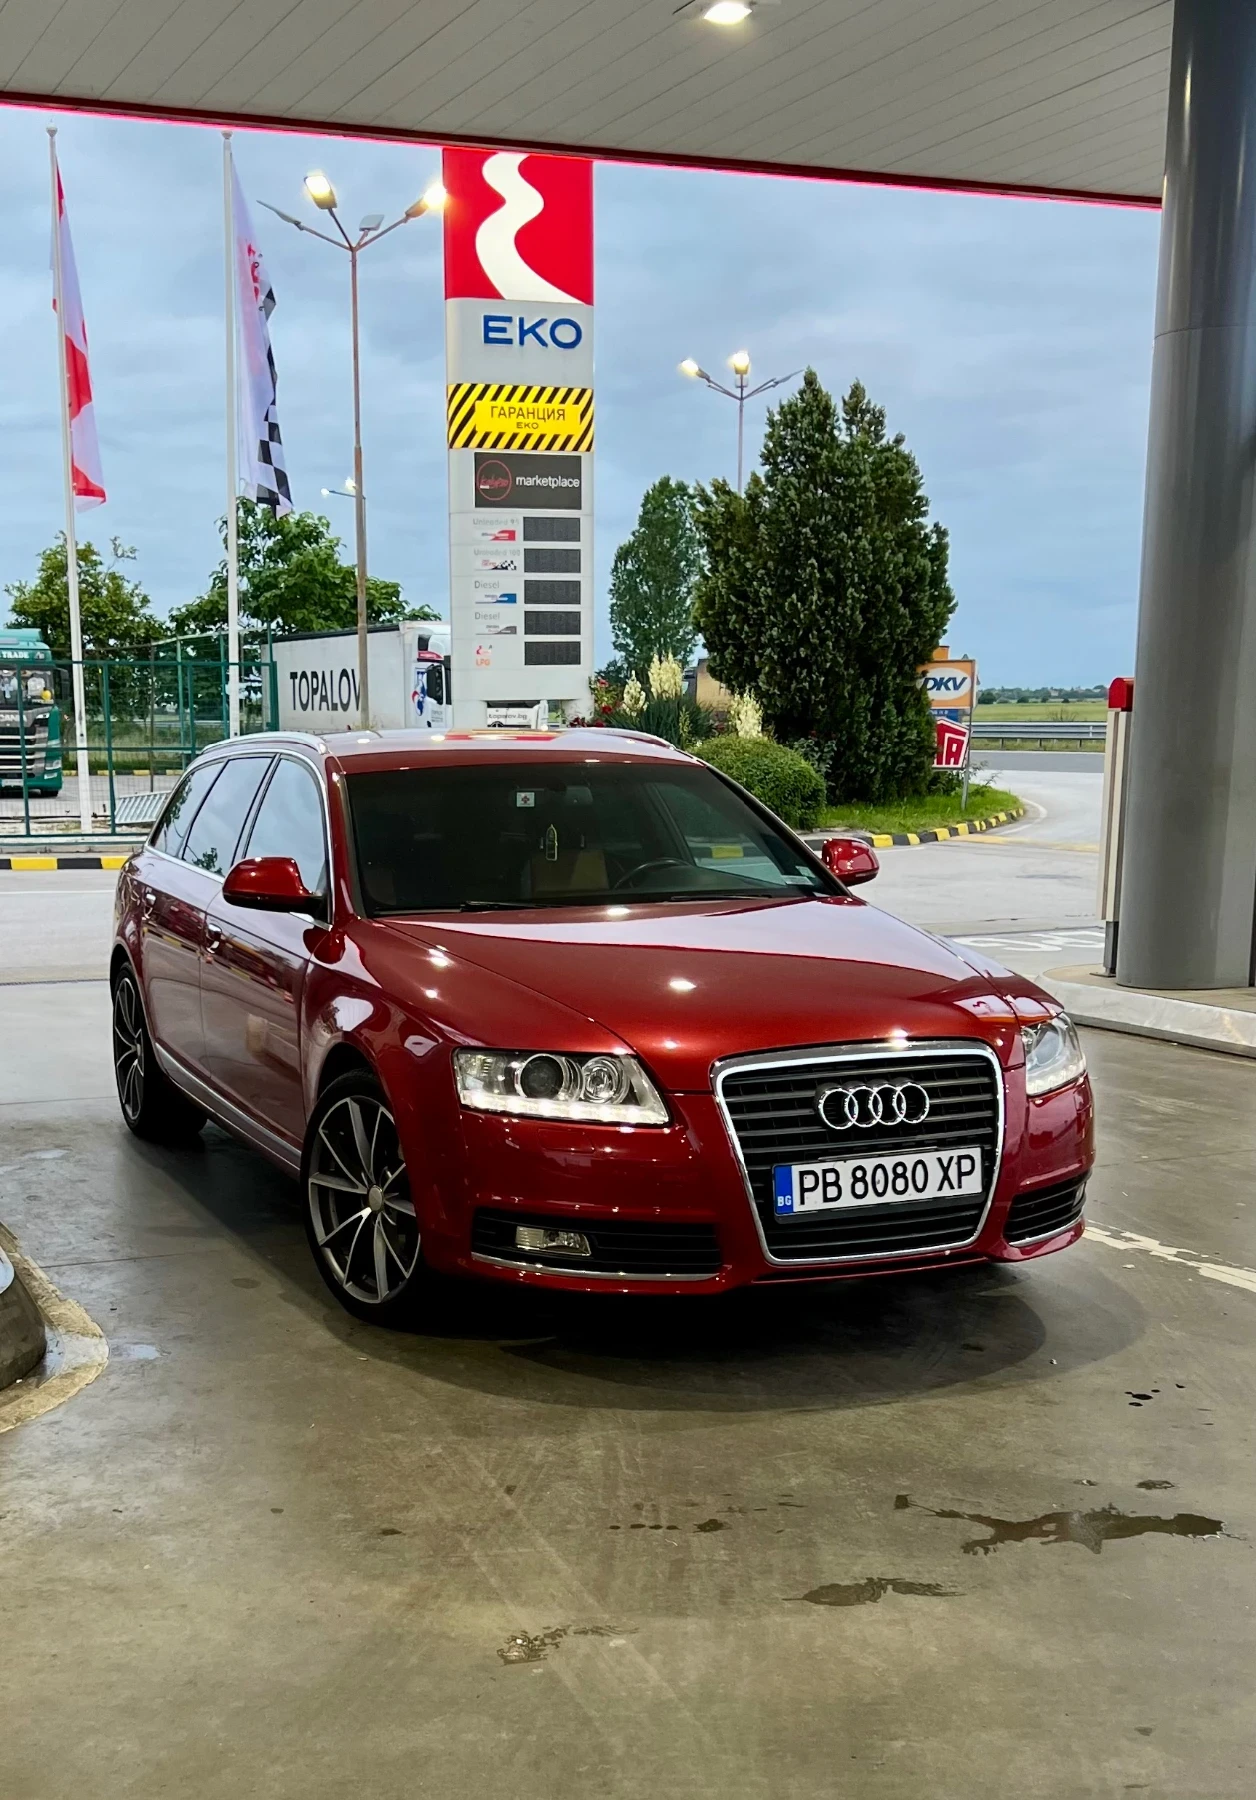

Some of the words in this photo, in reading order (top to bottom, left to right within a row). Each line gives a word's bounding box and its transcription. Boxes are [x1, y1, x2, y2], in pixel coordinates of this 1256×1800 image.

[483, 315, 582, 349] EKO
[490, 406, 566, 422] ГАРАНЦИЯ
[516, 422, 539, 430] EKO
[516, 475, 580, 488] marketplace
[475, 580, 500, 589] Diesel
[475, 612, 500, 620] Diesel
[2, 651, 29, 659] TRADE
[924, 676, 968, 691] DKV
[799, 1167, 842, 1205] PB
[851, 1159, 929, 1199] 8080
[937, 1153, 975, 1191] XP
[777, 1196, 792, 1206] BG
